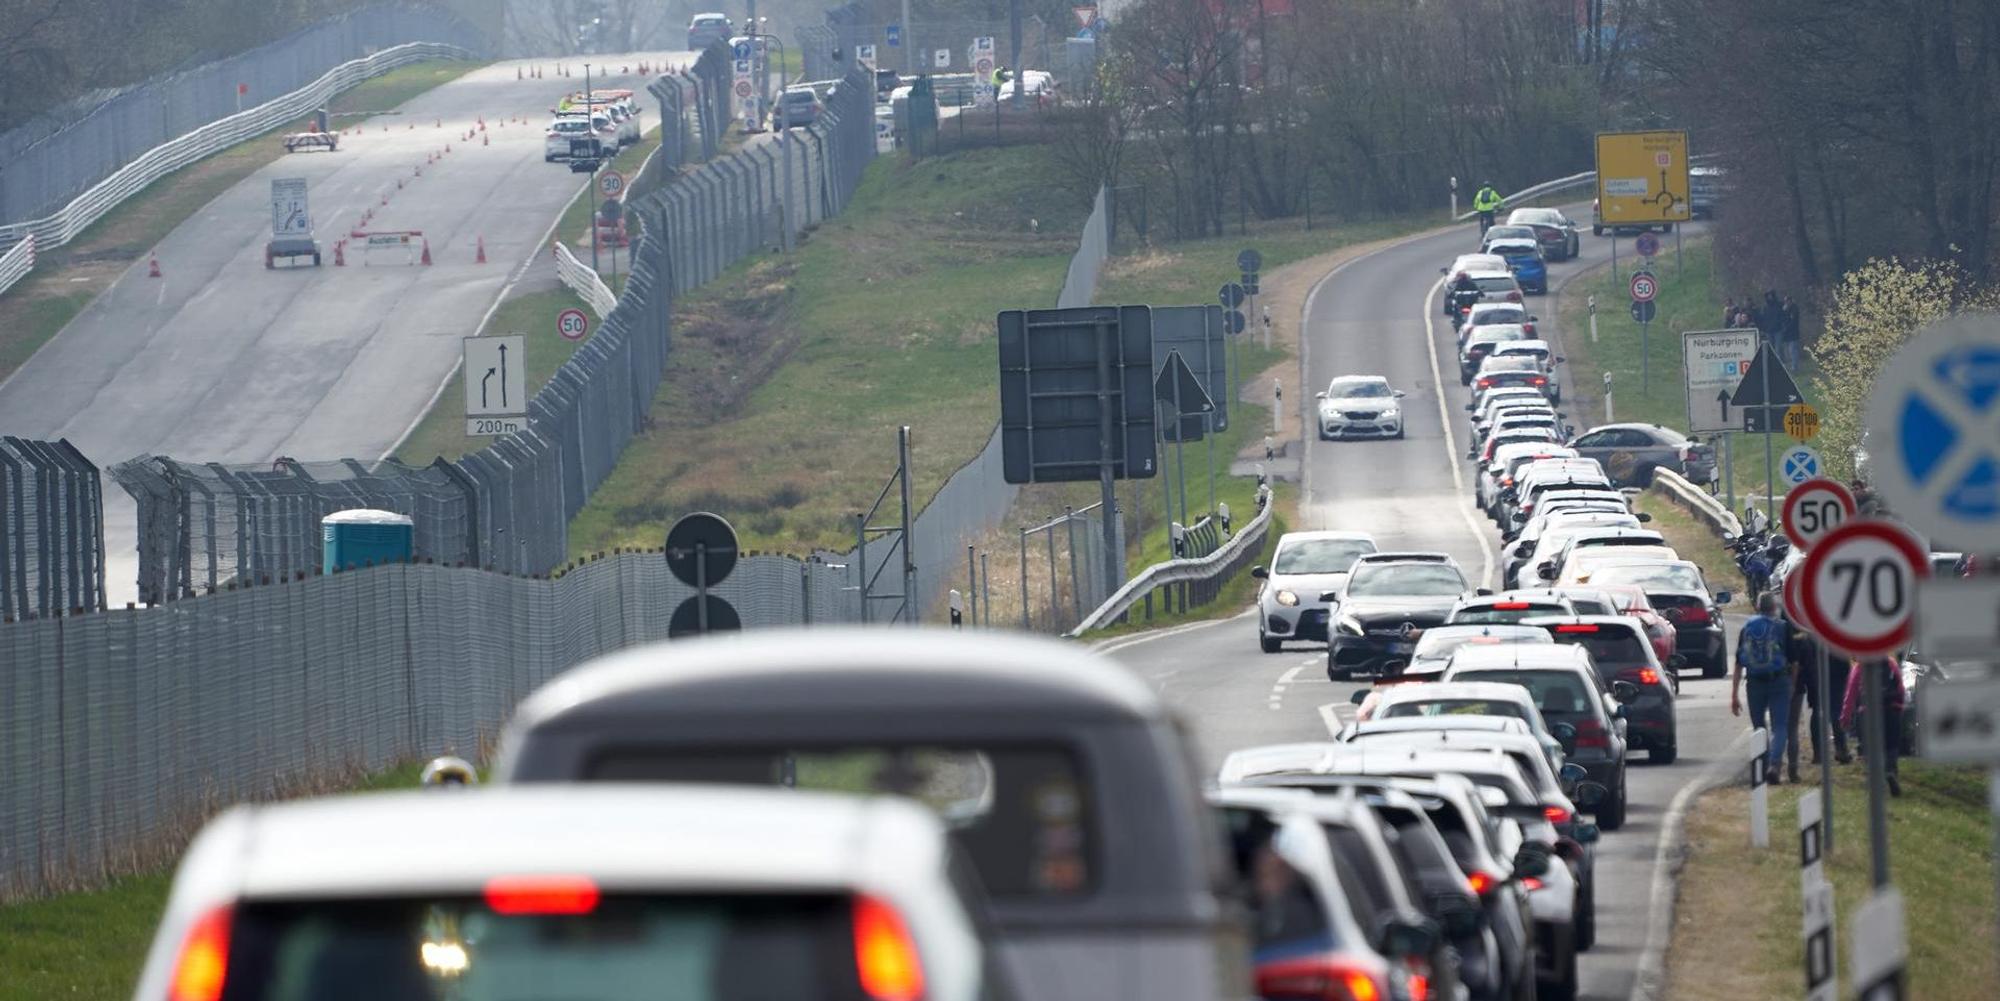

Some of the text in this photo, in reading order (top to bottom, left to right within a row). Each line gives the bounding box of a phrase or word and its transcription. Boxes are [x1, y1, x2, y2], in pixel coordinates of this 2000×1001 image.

[603, 178, 620, 190] 30
[1636, 283, 1650, 294] 50
[564, 318, 582, 331] 50
[1787, 412, 1800, 425] 30
[1800, 501, 1840, 533] 50
[1831, 558, 1904, 621] 70
